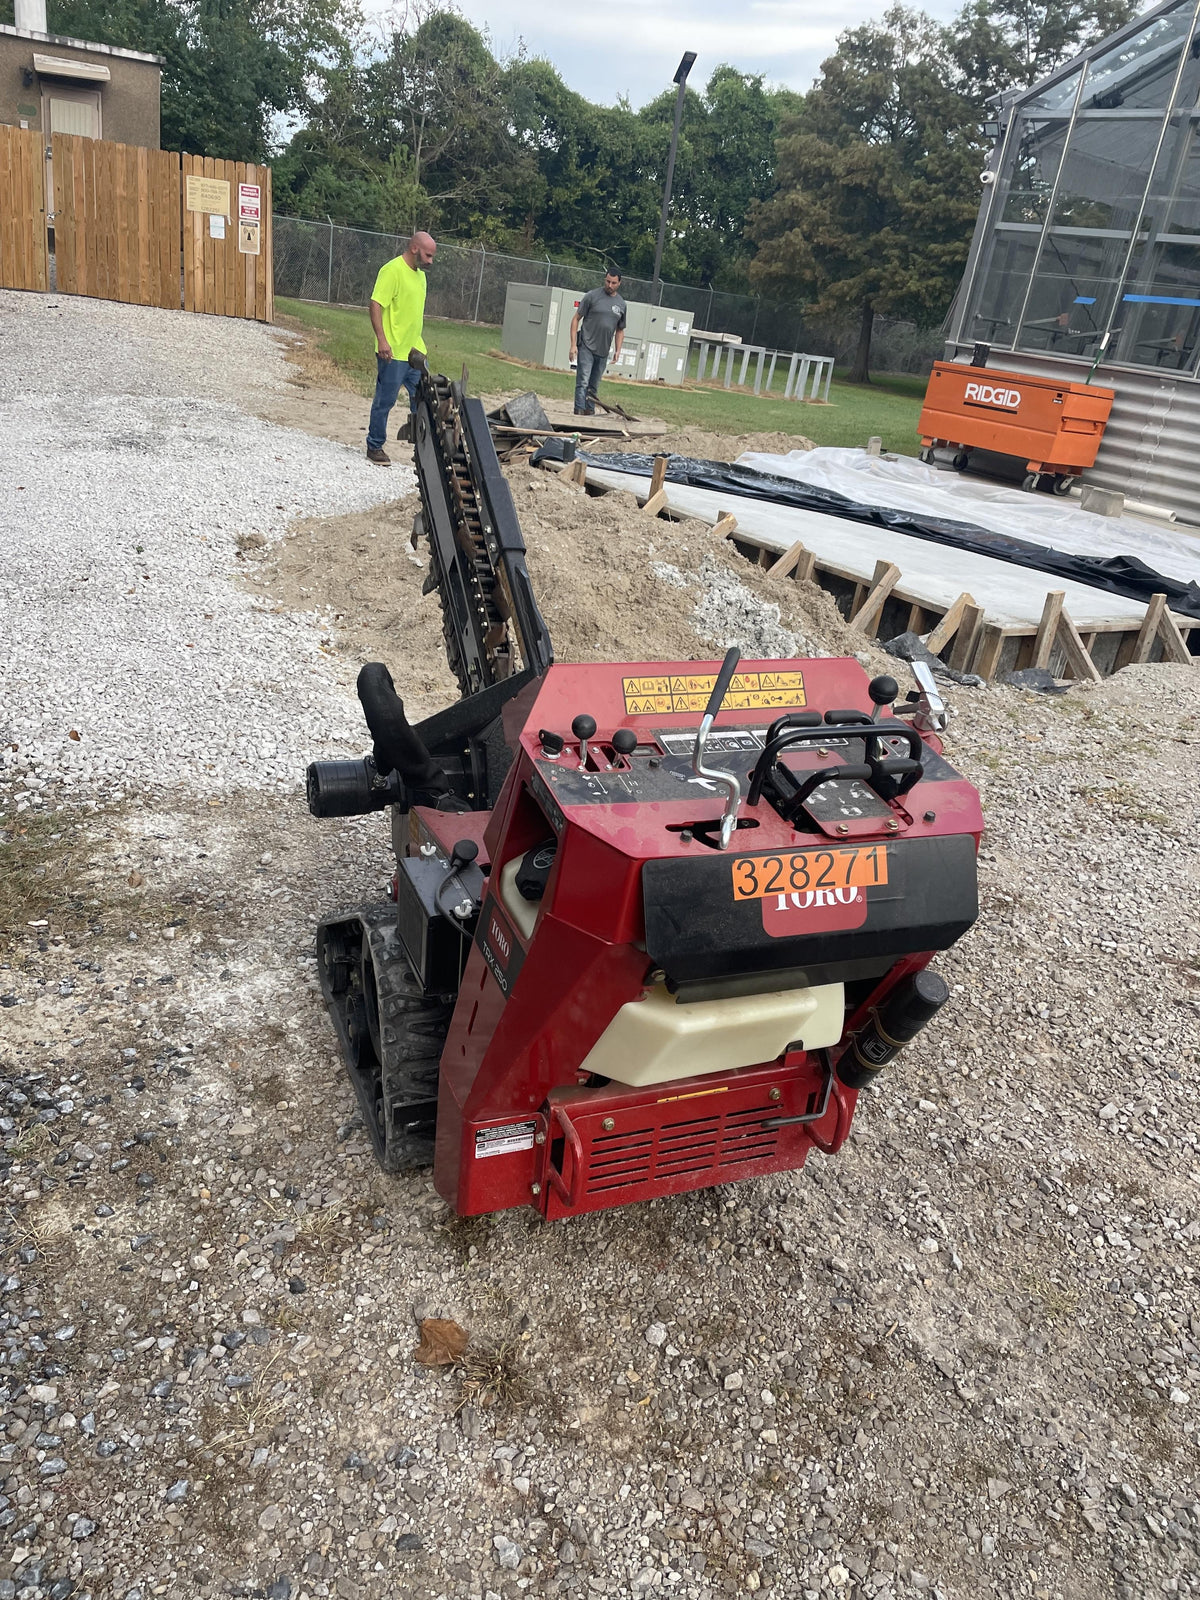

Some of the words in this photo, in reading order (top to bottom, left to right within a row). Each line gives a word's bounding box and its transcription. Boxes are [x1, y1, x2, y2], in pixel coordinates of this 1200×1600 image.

[964, 382, 1021, 407] RIDGID
[736, 846, 879, 896] 328271
[491, 918, 509, 955] TORO
